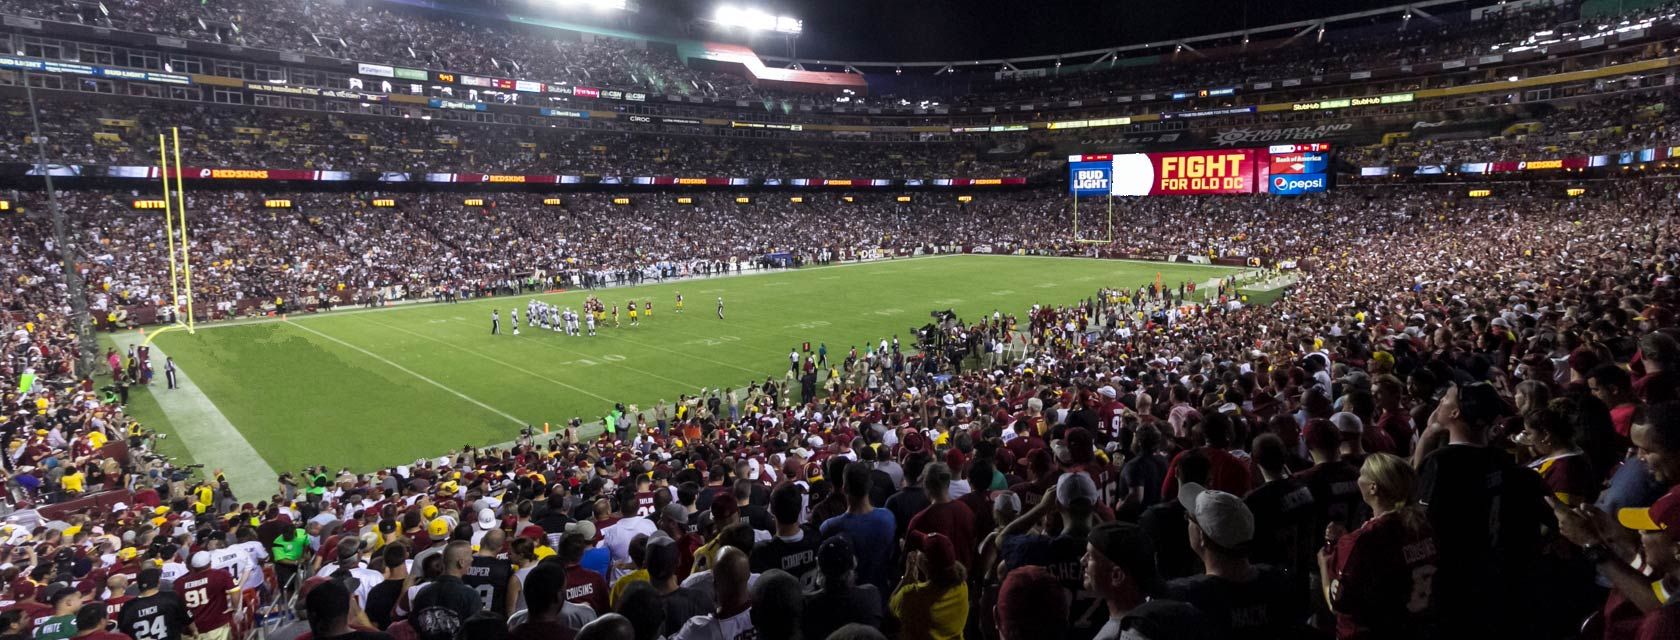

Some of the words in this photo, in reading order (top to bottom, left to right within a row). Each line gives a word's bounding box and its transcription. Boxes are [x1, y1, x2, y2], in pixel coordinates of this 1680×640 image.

[1351, 98, 1380, 106] StubHub
[1080, 136, 1154, 145] UNITED
[1162, 153, 1245, 178] FIGHT
[211, 169, 268, 179] REDSKINS
[489, 175, 526, 183] REDSKINS
[1078, 170, 1104, 180] BUD
[1073, 179, 1108, 189] LIGHT
[1161, 179, 1188, 190] FOR
[1191, 178, 1220, 190] OLD
[1223, 177, 1244, 189] DC
[1289, 178, 1323, 190] pepsi
[780, 549, 815, 570] COOPER
[466, 566, 491, 577] OOPER
[565, 583, 594, 600] COUSINS
[184, 588, 209, 608] 91
[138, 605, 158, 618] LYNCH
[133, 615, 168, 640] 24
